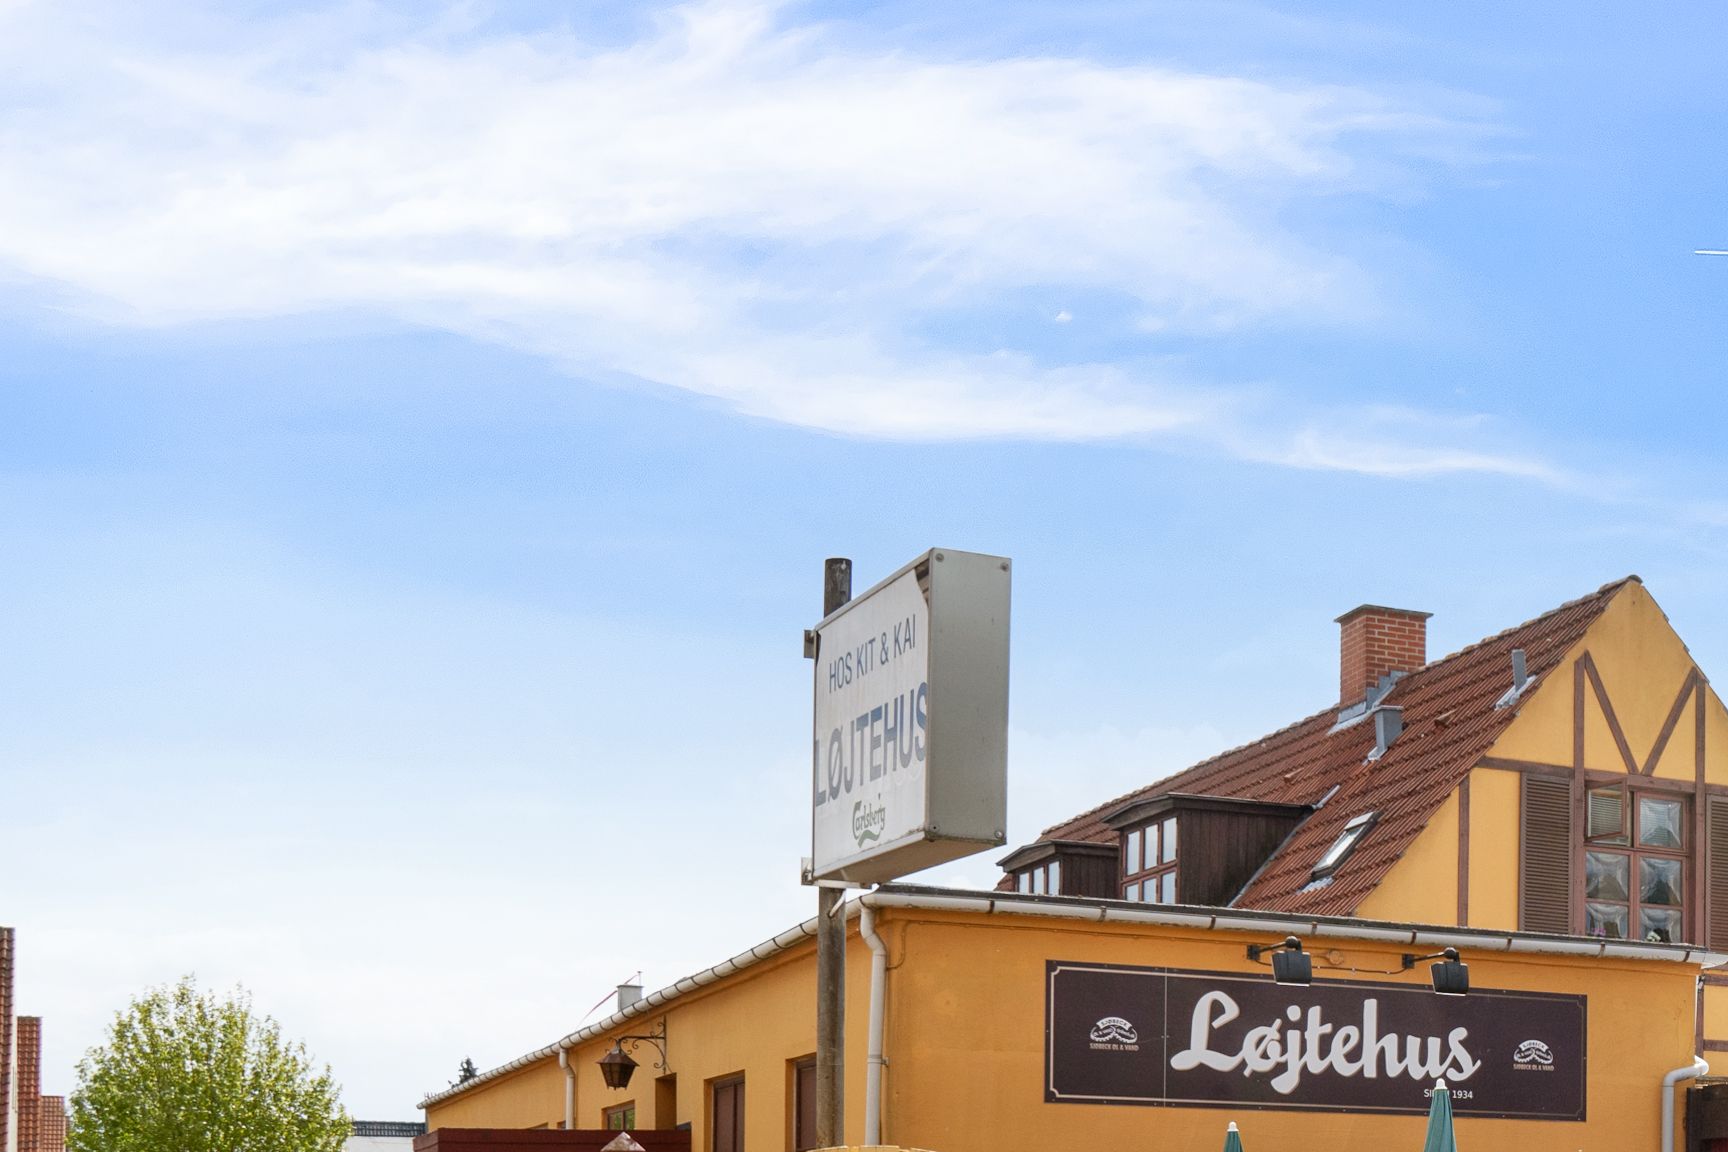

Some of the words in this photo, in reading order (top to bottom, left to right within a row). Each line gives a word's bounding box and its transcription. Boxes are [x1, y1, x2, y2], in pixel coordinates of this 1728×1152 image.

[829, 652, 853, 694] HOS
[856, 637, 876, 680] KIT
[879, 631, 890, 666] &
[893, 613, 916, 658] KAI
[815, 682, 928, 808] LØJTEHUS
[852, 800, 886, 848] Carlsberg
[1170, 990, 1482, 1094] Løjtehus
[1452, 1090, 1473, 1099] 1934
